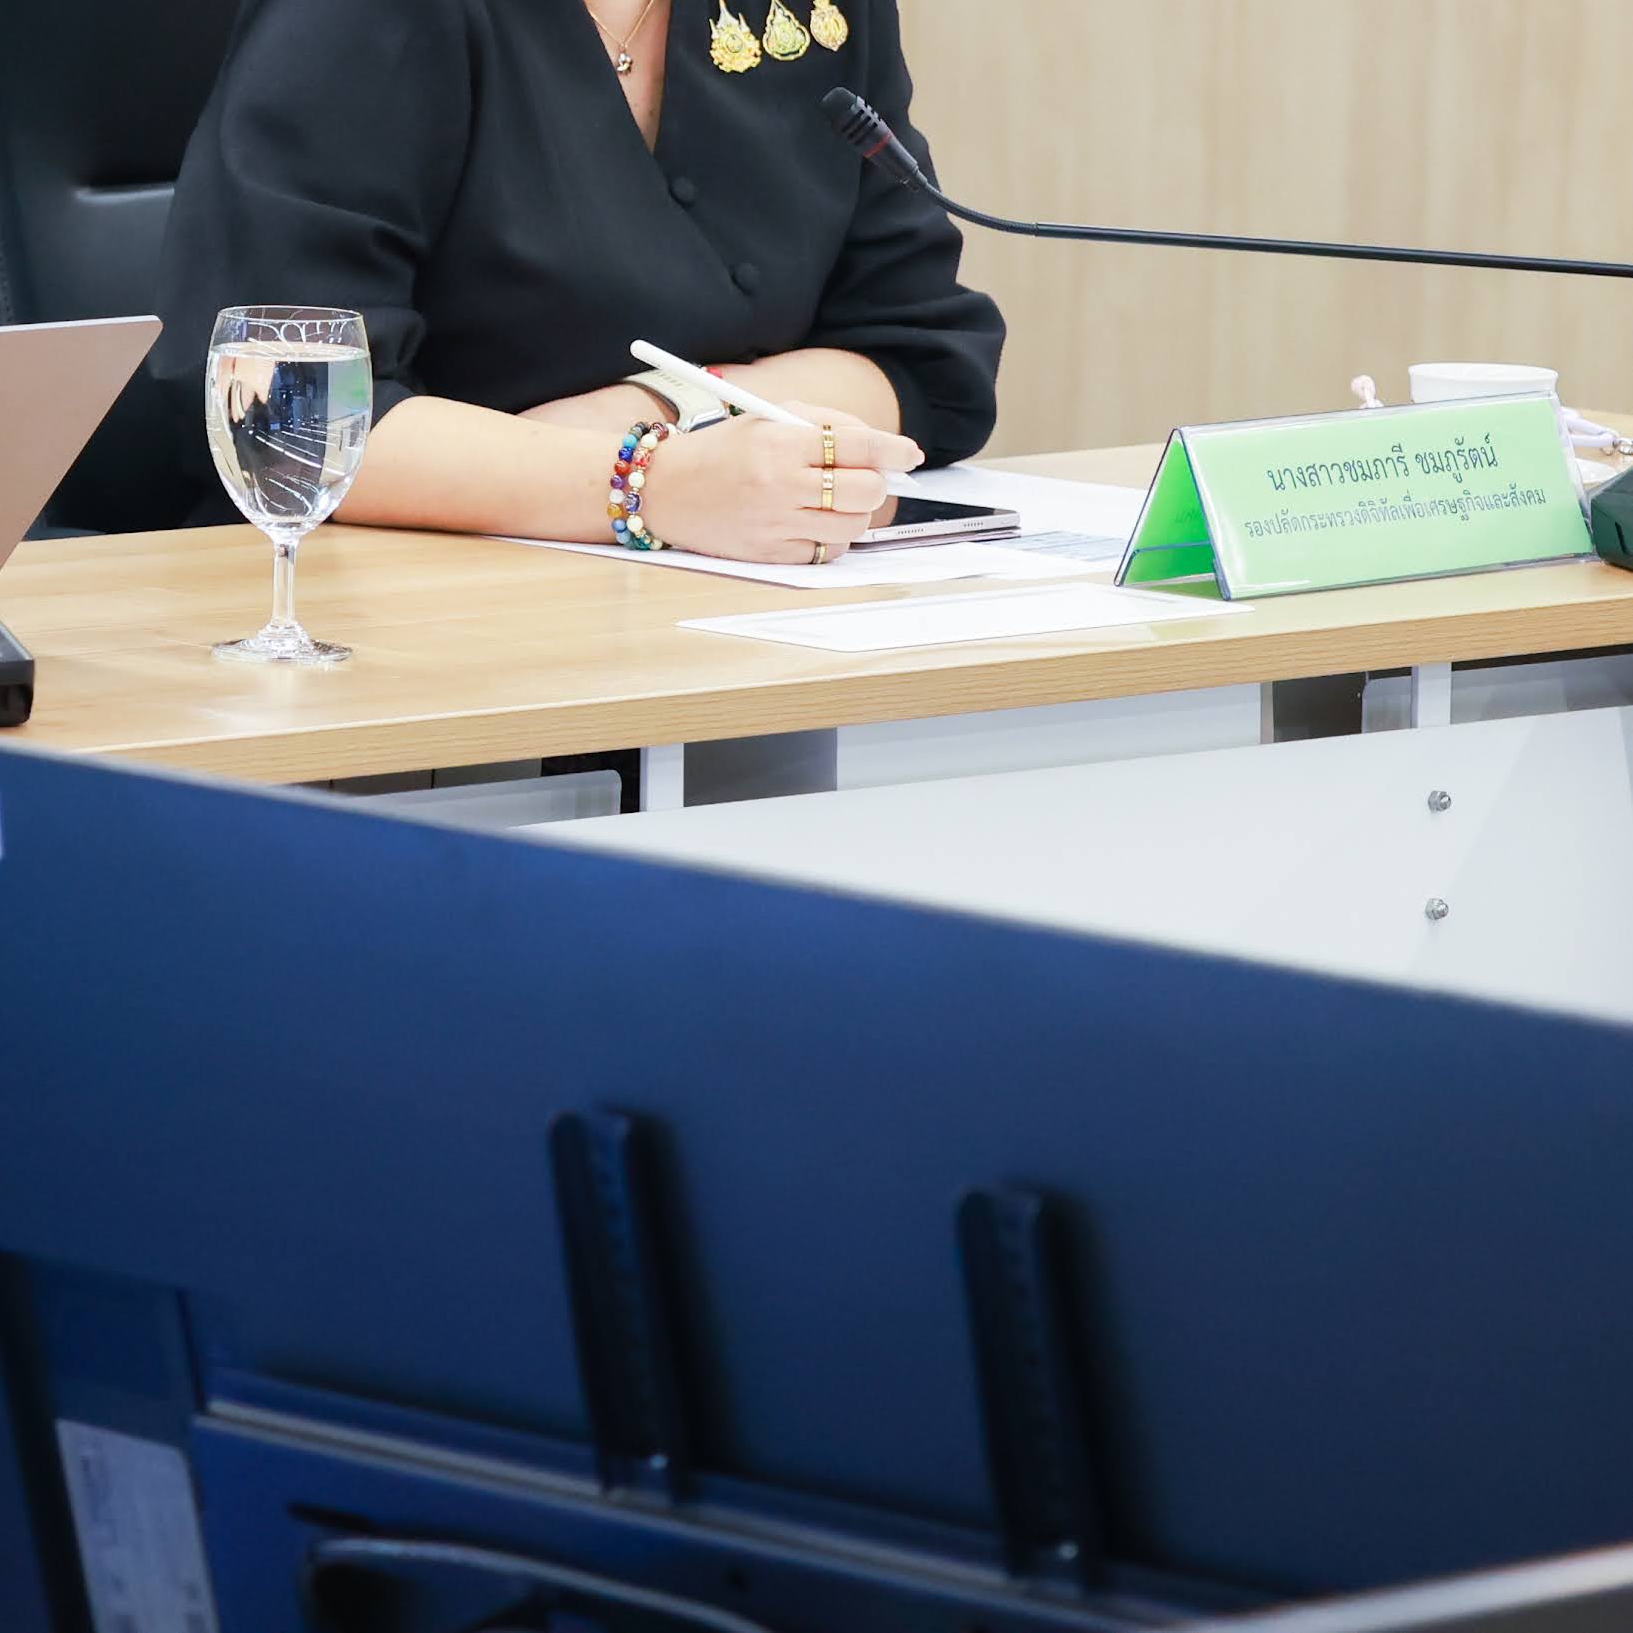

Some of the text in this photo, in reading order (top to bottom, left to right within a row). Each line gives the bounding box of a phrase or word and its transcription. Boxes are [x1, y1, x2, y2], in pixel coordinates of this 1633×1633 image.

[1266, 432, 1499, 491] นางสาวชมภารี ชมภูรัตน์
[1244, 482, 1548, 538] รองปลัดกระทรวงดิจิทัลเพื่อเศรษฐกิจและสังคม
